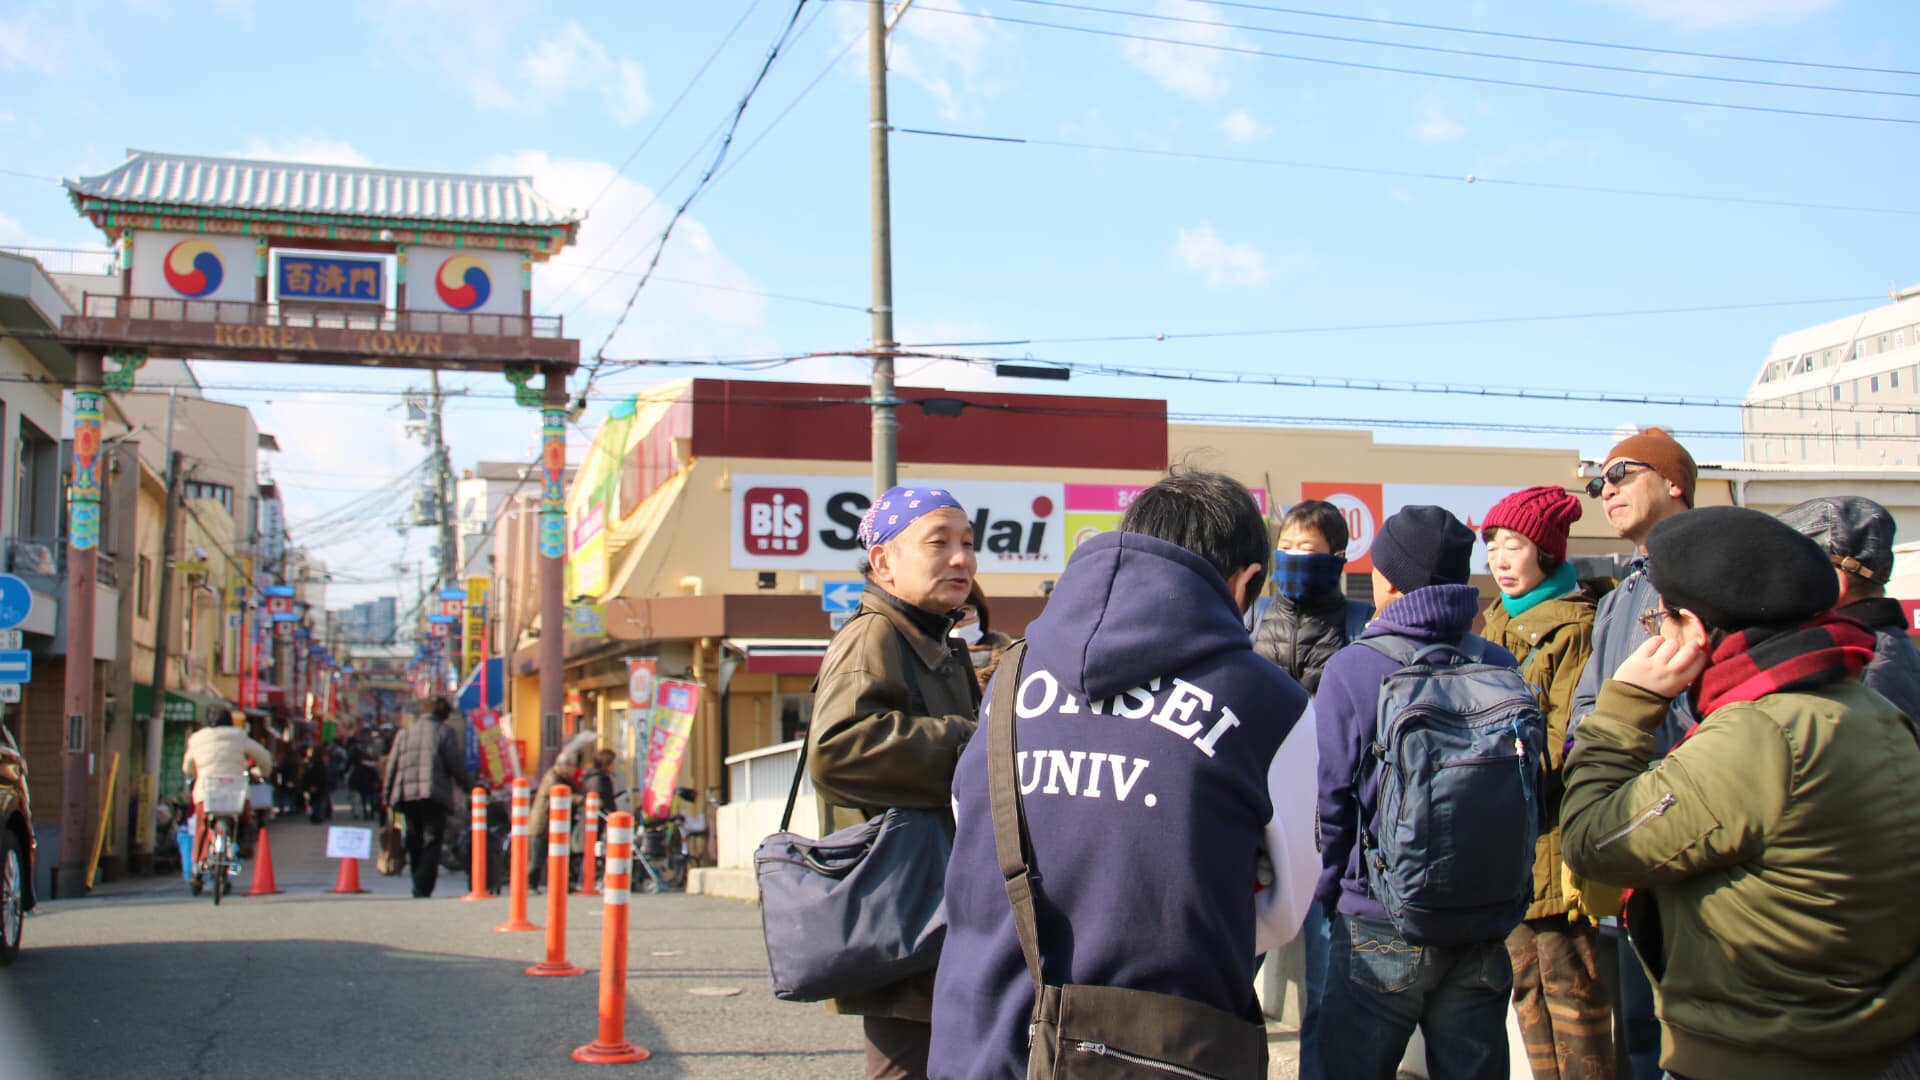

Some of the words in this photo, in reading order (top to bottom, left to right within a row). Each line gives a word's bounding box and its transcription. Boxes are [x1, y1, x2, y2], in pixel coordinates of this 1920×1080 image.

[214, 324, 319, 350] KOREA
[357, 331, 443, 355] TOWN
[1017, 750, 1157, 808] UNIV.
